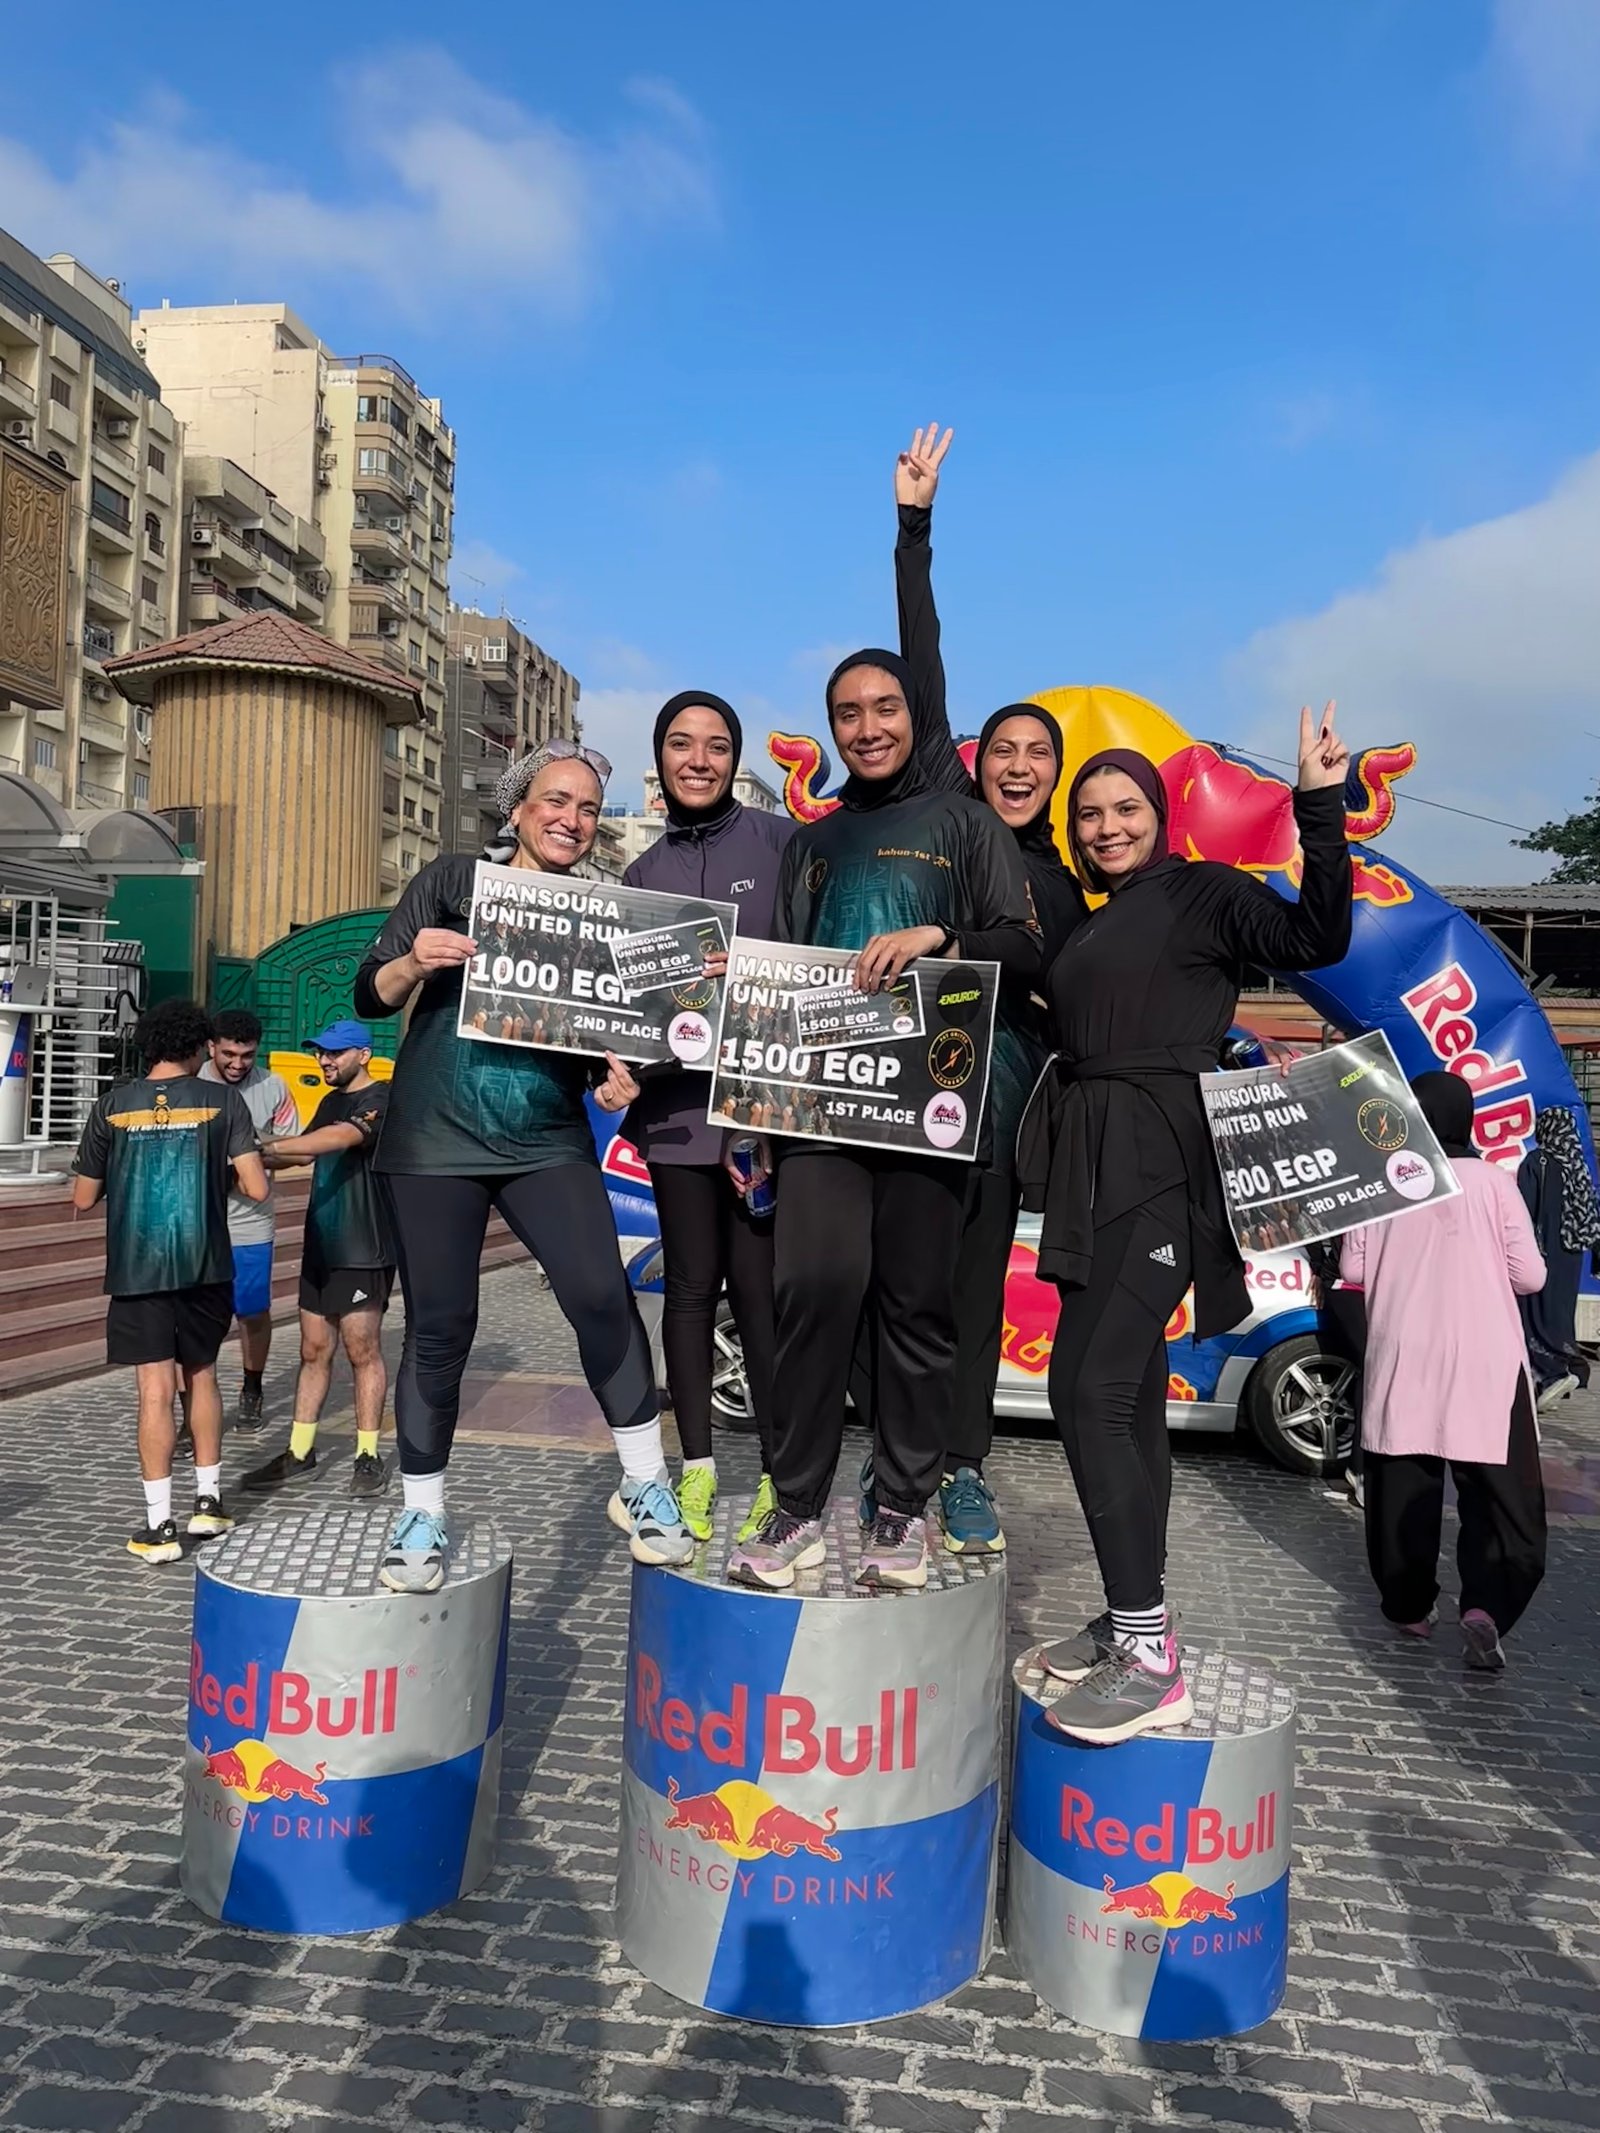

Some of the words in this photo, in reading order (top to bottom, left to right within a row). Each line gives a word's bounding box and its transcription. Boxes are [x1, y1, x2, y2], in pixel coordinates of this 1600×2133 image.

[481, 877, 620, 920] MANSOURA
[479, 903, 572, 936] UNITED
[615, 934, 672, 949] MANSOURA
[616, 946, 655, 959] UNITED
[657, 941, 679, 951] RUN
[470, 953, 560, 992] 1000
[620, 961, 656, 977] 1000
[660, 953, 691, 969] EGP
[799, 989, 863, 1003] MANSOURA
[800, 1000, 841, 1012] UNITED
[844, 996, 869, 1006] RUN
[573, 1015, 606, 1033] 2ND
[613, 1020, 662, 1041] PLACE
[800, 1017, 840, 1032] 1500
[844, 1011, 879, 1026] EGP
[1406, 966, 1522, 1092] Red
[720, 1037, 811, 1077] 1500
[822, 1051, 901, 1088] EGP
[1204, 1081, 1288, 1111] MANSOURA
[825, 1101, 857, 1118] 1ST
[861, 1105, 917, 1126] PLACE
[1209, 1113, 1262, 1138] UNITED
[1266, 1103, 1308, 1129] RUN
[1226, 1164, 1271, 1201] 500
[1272, 1147, 1338, 1189] EGP
[1305, 1199, 1336, 1216] 3RD
[1339, 1180, 1388, 1207] PLACE
[1149, 1251, 1177, 1267] adidas
[190, 1639, 259, 1730] Red
[268, 1667, 398, 1737] Bull
[635, 1651, 748, 1768] Red
[763, 1687, 918, 1776] Bull
[273, 1813, 375, 1840] DRINK
[1060, 1783, 1175, 1864] Red
[1187, 1791, 1276, 1864] Bull
[637, 1827, 756, 1898] ENERGY
[773, 1871, 896, 1904] DRINK
[1067, 1914, 1181, 1956] ENERGY
[1192, 1923, 1264, 1956] DRINK
